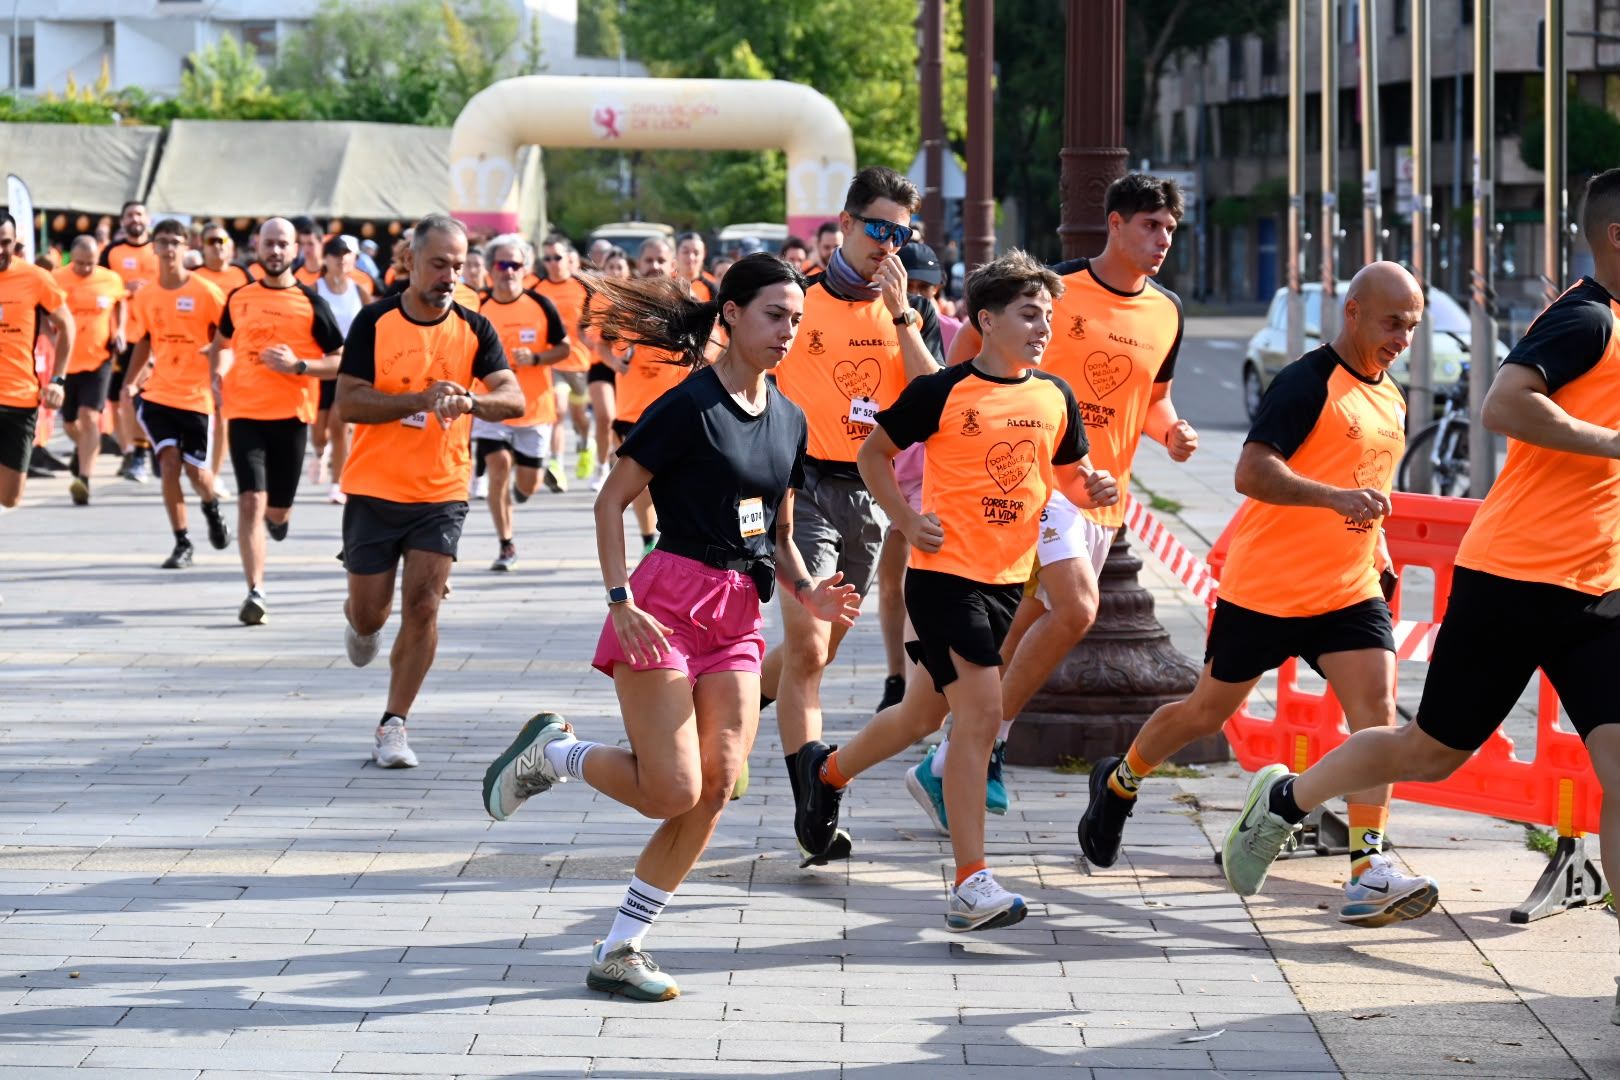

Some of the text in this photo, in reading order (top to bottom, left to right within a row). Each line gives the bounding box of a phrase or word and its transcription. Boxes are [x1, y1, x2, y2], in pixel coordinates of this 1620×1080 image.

[849, 338, 883, 347] ALCLES
[1078, 401, 1116, 417] CORRE POR
[1081, 411, 1090, 421] LA
[1007, 419, 1042, 428] ALCLES
[846, 425, 874, 435] LA VID
[981, 496, 1024, 511] CORRE POR
[984, 506, 996, 518] LA
